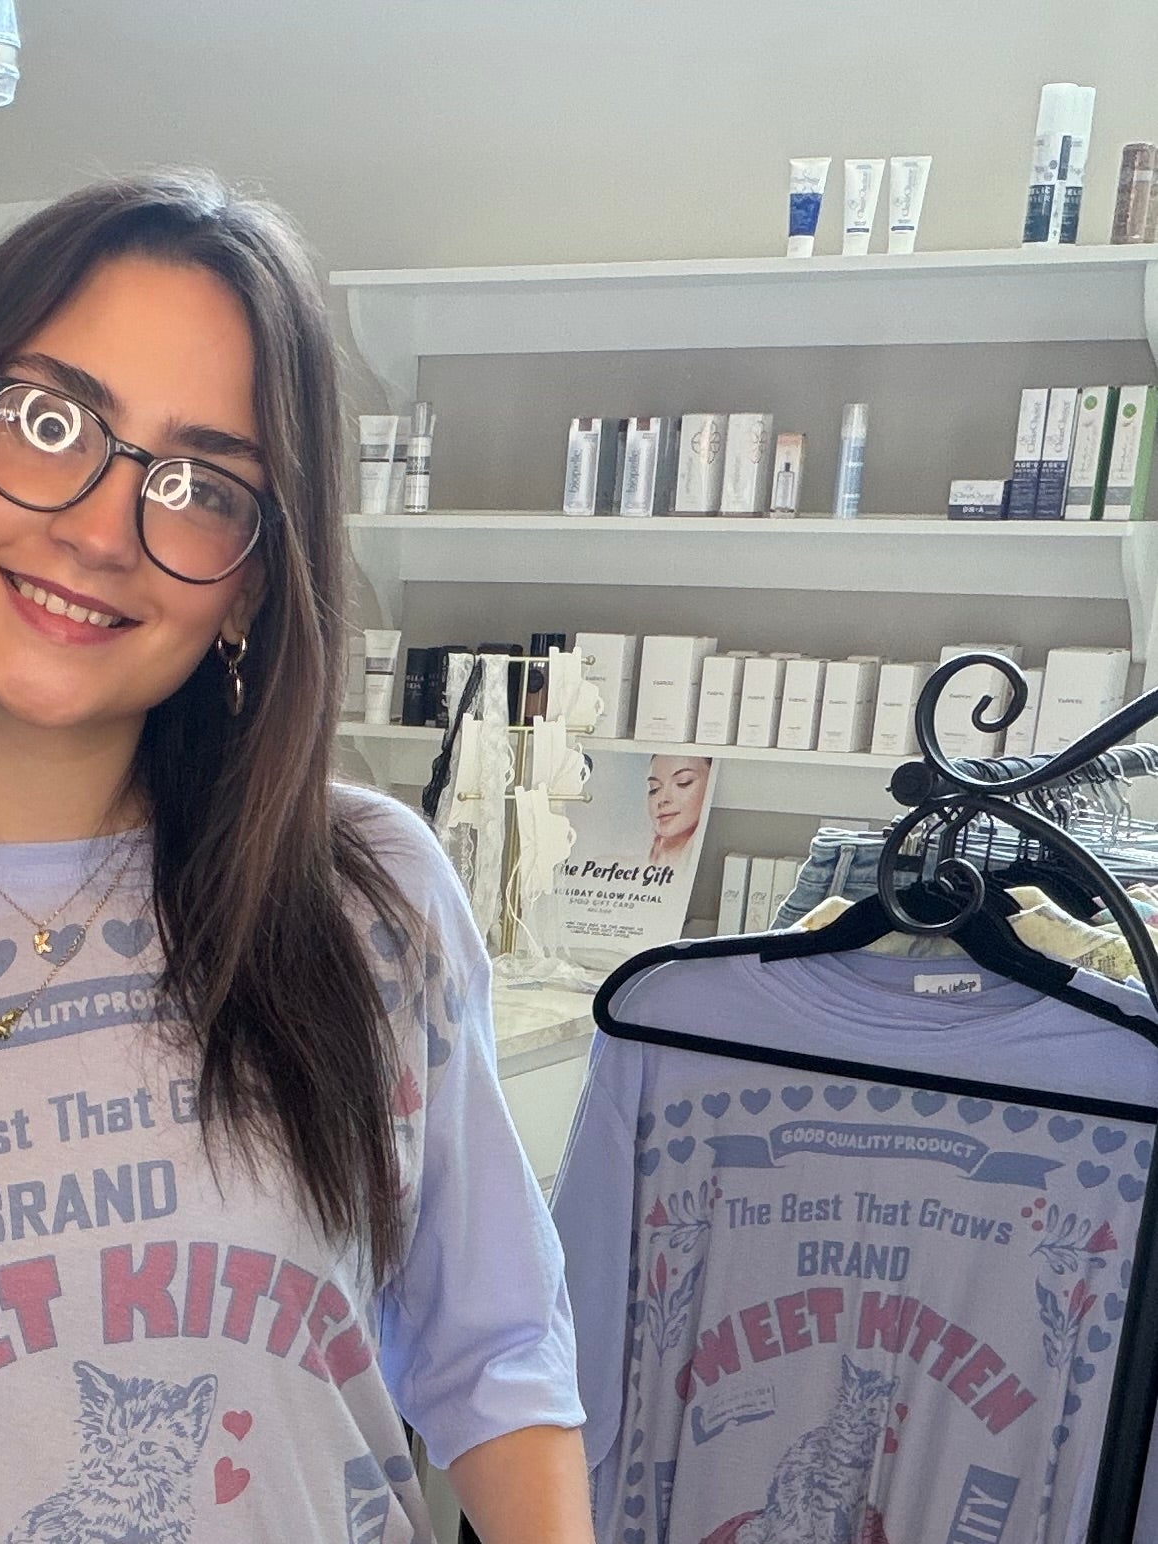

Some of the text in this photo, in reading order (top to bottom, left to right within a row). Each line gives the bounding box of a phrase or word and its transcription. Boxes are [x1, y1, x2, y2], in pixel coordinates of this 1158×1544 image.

[582, 860, 640, 881] Perfect
[642, 865, 674, 886] Gift
[554, 888, 662, 903] LIDAY GLOW FACIAL
[48, 1088, 155, 1142] That
[781, 1127, 977, 1159] GOOD QUALITY PRODUCT
[725, 1192, 1014, 1246] The Best That Grows
[798, 1240, 911, 1283] BRAND
